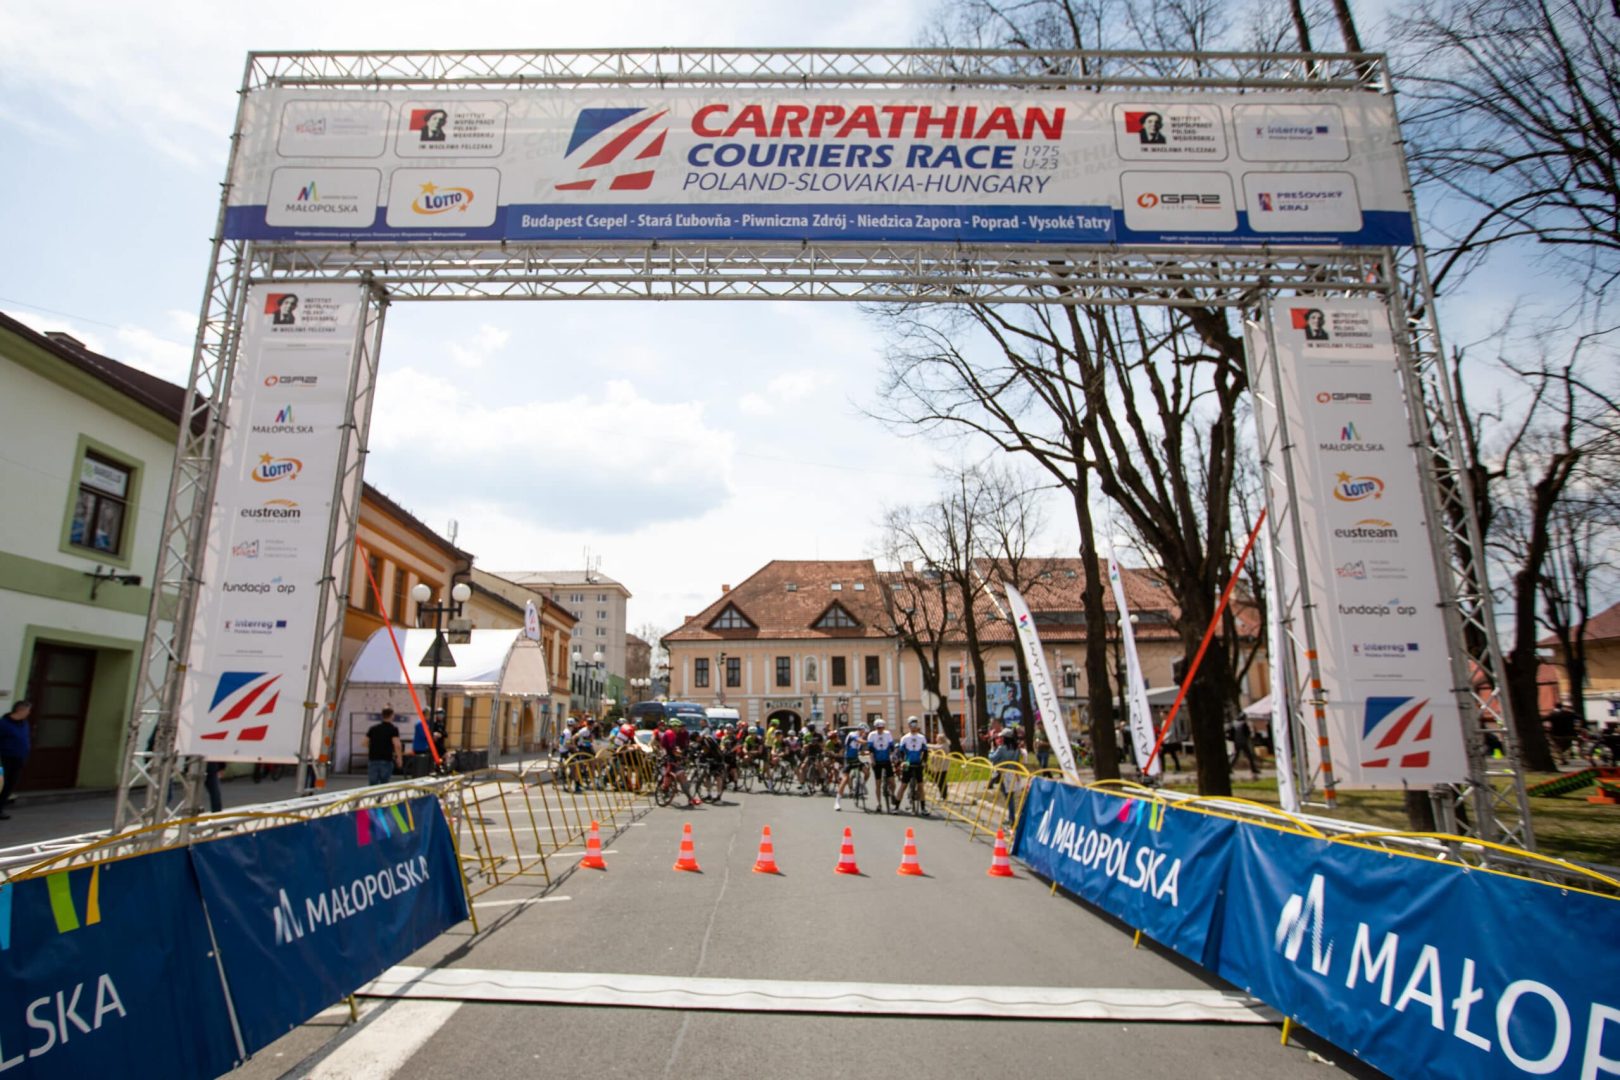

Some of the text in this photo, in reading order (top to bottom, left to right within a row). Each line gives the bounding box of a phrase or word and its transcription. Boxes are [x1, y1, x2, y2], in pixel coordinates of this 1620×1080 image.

[690, 104, 1066, 140] CARPATHIAN
[687, 143, 1016, 170] COURIERS RACE
[1024, 144, 1060, 157] 1975
[1022, 158, 1058, 170] U-23
[682, 172, 1052, 194] POLAND-SLOVAKIA-HUNGARY
[424, 192, 462, 208] LOTTO
[285, 204, 358, 213] MAŁOPOLSKA
[522, 214, 584, 228] Budapest
[586, 215, 628, 228] Csepel
[638, 214, 672, 227] Stará
[675, 214, 731, 227] Ľubovňa
[742, 214, 808, 227] Piwniczna
[812, 214, 846, 230] Zdrój
[858, 214, 912, 228] Niedzica
[916, 215, 962, 231] Zapora
[972, 215, 1019, 231] Poprad
[1029, 215, 1075, 232] Vysoké
[1076, 216, 1111, 232] Tatry
[252, 425, 314, 434] MAŁOPOLSKA
[1320, 443, 1385, 452] MAŁOPOLSKA
[262, 462, 293, 478] LOTTO
[1342, 482, 1375, 497] LOTTO
[240, 508, 301, 518] eustream
[1334, 528, 1398, 538] eustream
[222, 582, 296, 594] fundacja arp
[1338, 604, 1416, 617] fundacja arp
[1051, 818, 1181, 907] MAŁOPOLSKA
[305, 855, 430, 933] MAŁOPOLSKA
